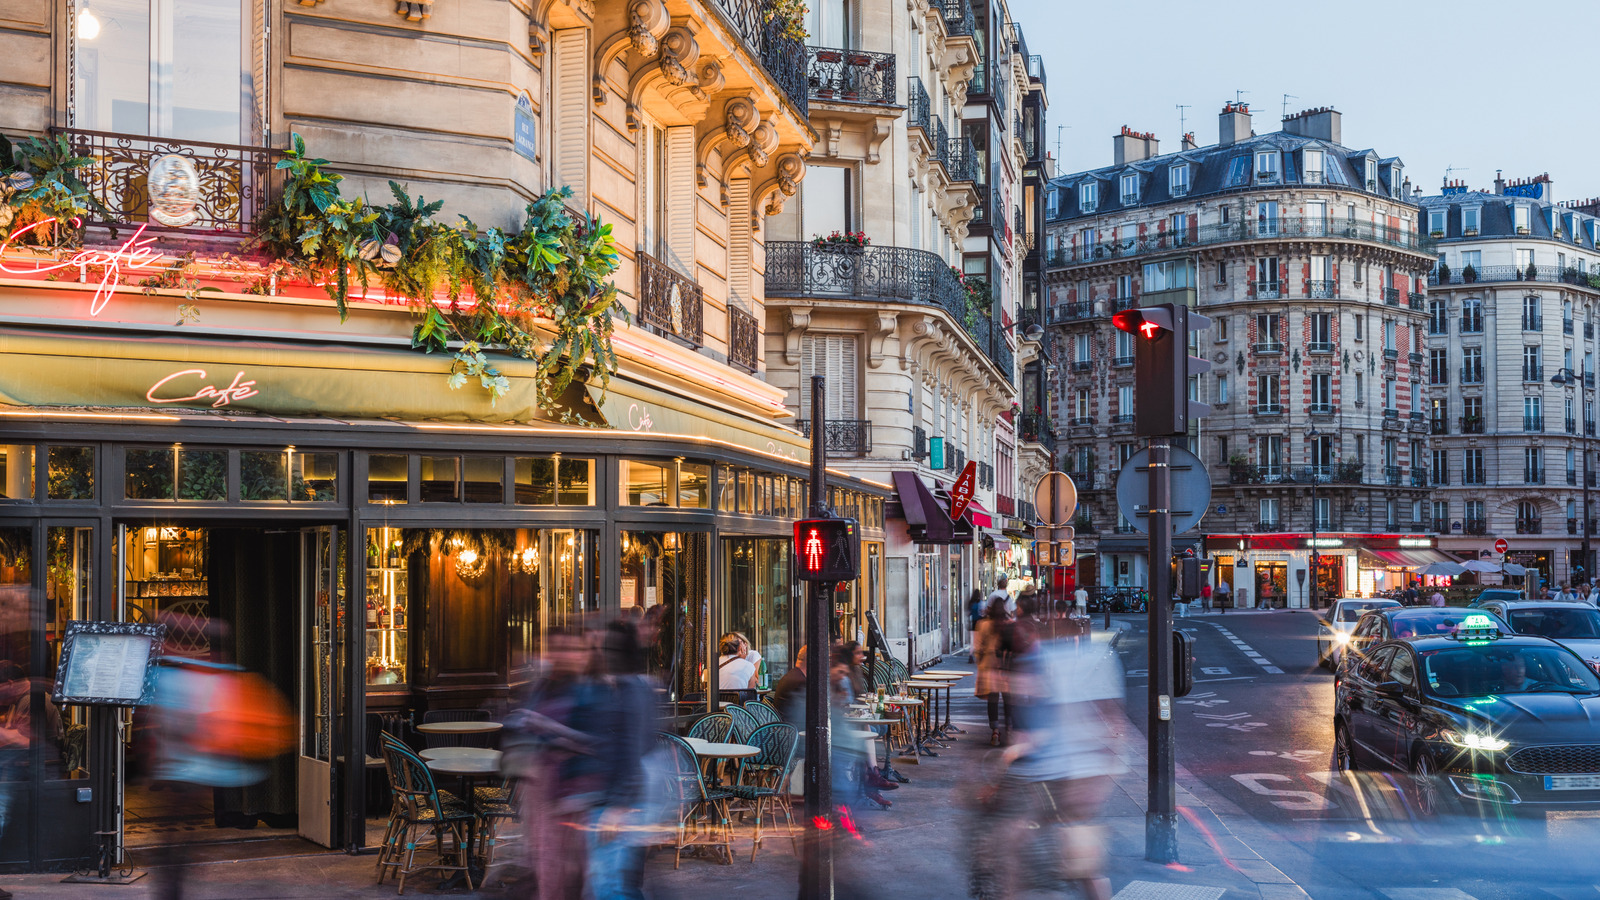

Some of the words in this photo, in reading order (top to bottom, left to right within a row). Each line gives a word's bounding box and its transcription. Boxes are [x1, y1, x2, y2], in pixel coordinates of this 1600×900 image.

[0, 217, 164, 316] Café
[147, 369, 259, 408] Café
[628, 404, 653, 432] Café
[956, 474, 971, 507] TABAC
